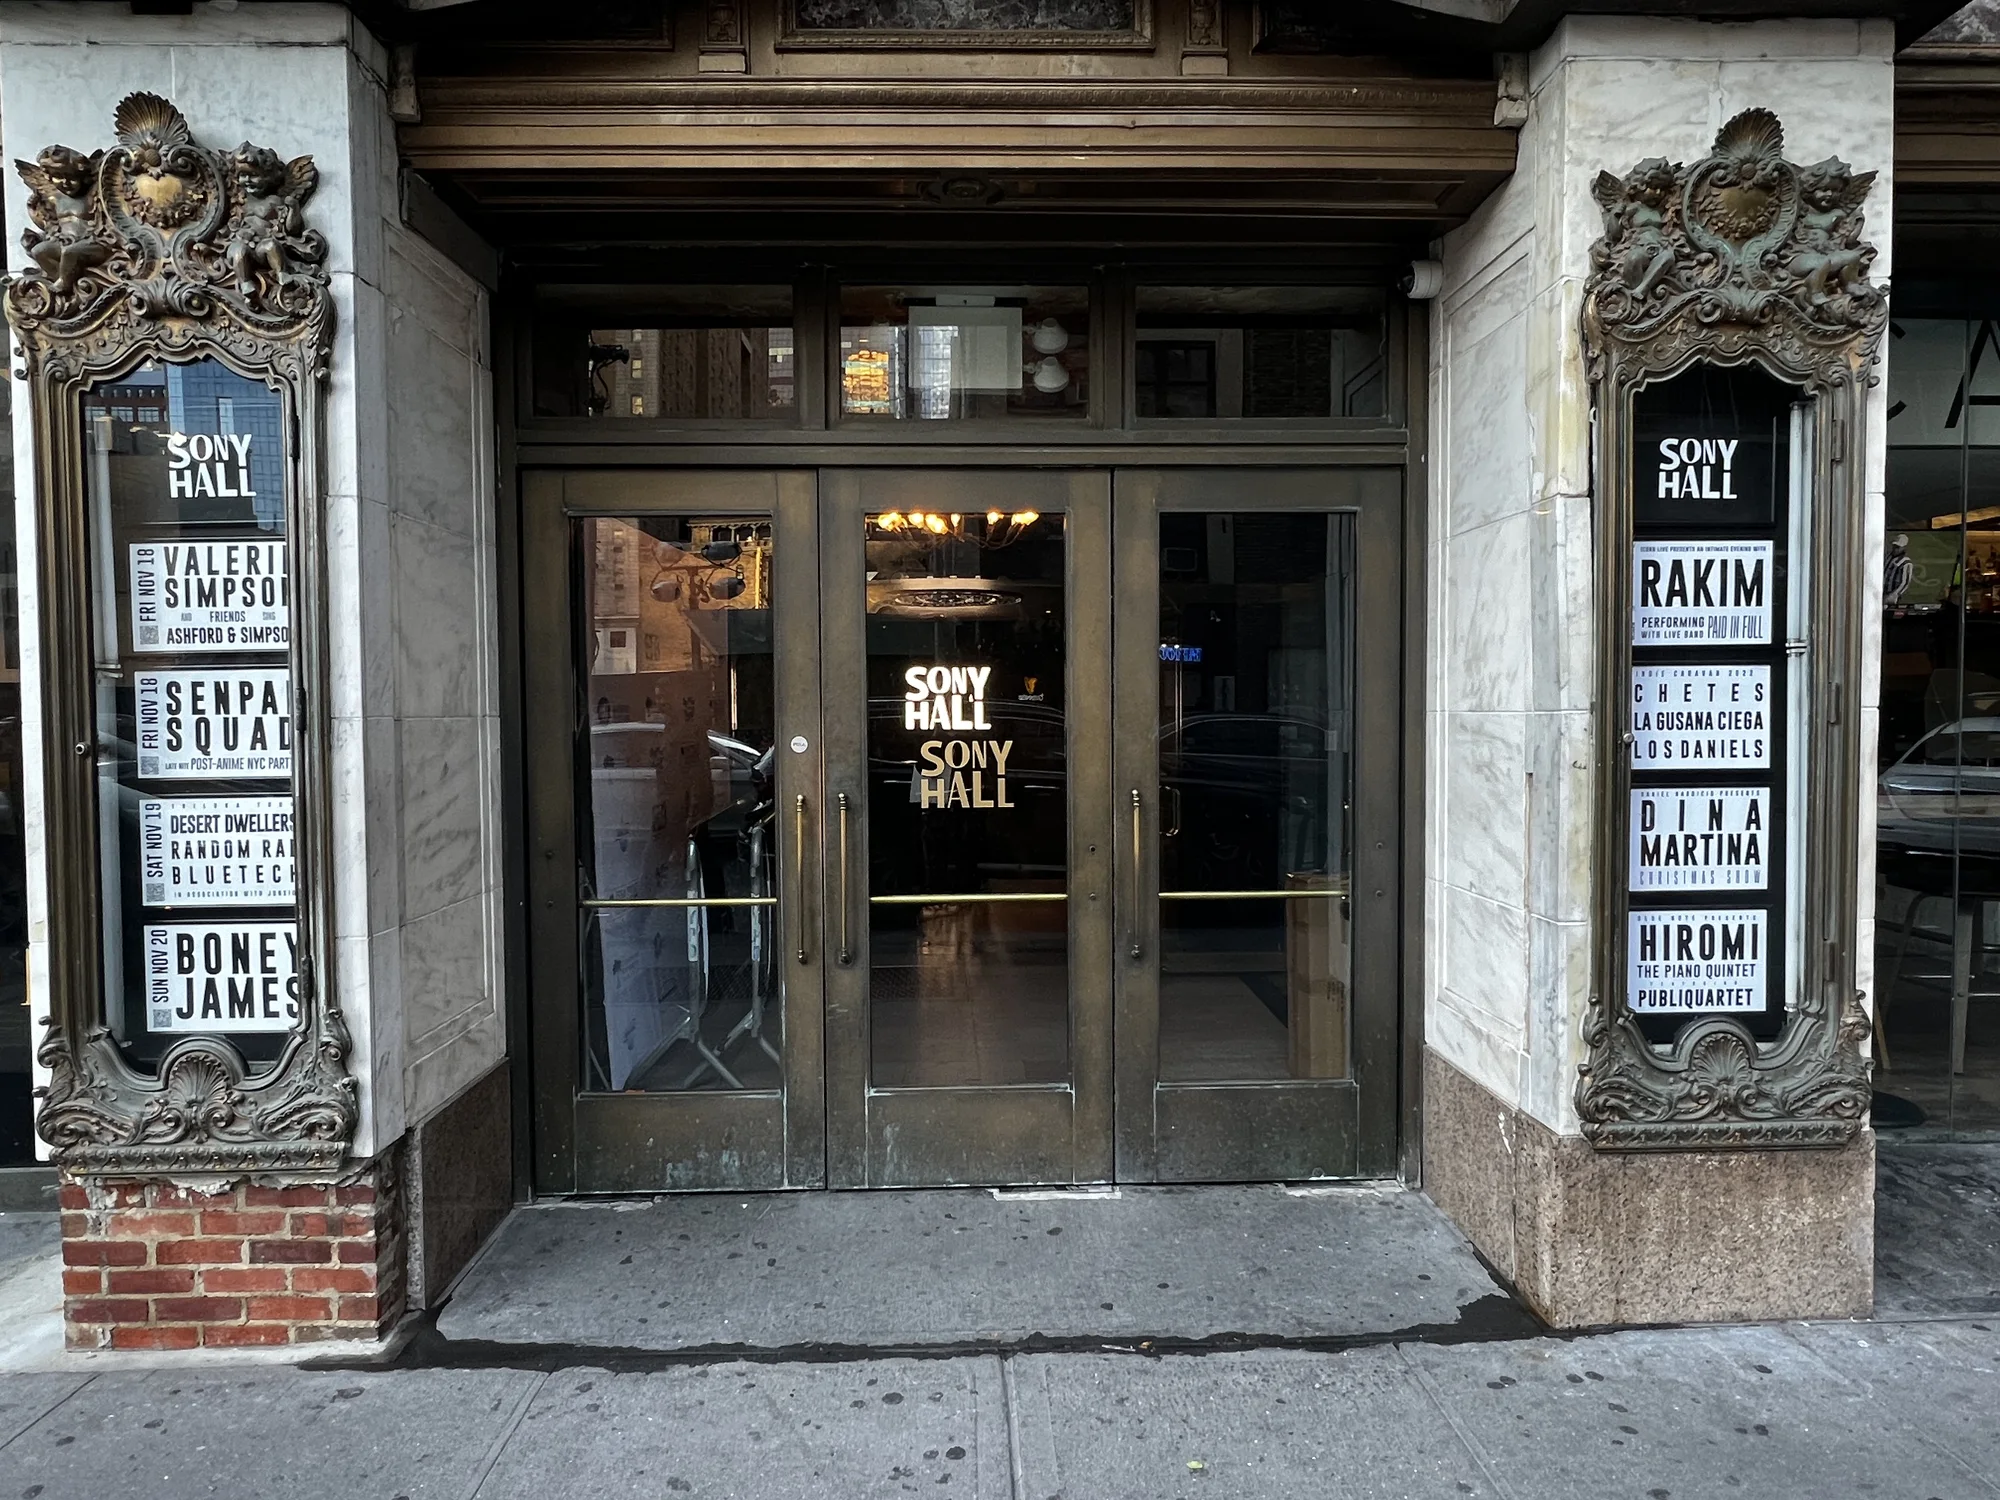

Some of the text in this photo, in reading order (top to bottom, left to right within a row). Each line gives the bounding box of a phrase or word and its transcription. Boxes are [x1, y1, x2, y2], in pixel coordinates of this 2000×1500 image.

[168, 434, 252, 469] SONY
[1659, 437, 1739, 471] SONY
[169, 462, 257, 498] HALL
[1658, 465, 1738, 499] HALL
[164, 545, 286, 577] VALERI
[137, 548, 156, 622] FRI NOV 18
[1641, 559, 1764, 607] RAKIM
[210, 611, 246, 623] FRIENDS
[1641, 616, 1705, 628] PERFORMING
[1708, 615, 1763, 638] PAID IN FULL
[167, 627, 223, 644] ASHFORD
[228, 627, 236, 643] &
[1641, 631, 1660, 639] WITH
[1684, 630, 1704, 638] BAND
[905, 666, 991, 701] SONY
[1634, 683, 1763, 703] CHETES
[141, 678, 158, 749] FRI NOV 18
[905, 694, 991, 730] HALL
[1634, 711, 1763, 731] LA GUSANA CIEGA
[166, 717, 290, 755] SQUAD
[1634, 739, 1763, 759] LOS DANIELS
[191, 757, 244, 770] POST-ANIME
[248, 757, 265, 770] NYC
[268, 757, 291, 769] PART
[920, 740, 1013, 777] SONY
[920, 771, 1014, 809] HALL
[171, 814, 220, 834] DESERT
[1641, 799, 1761, 832] DINA
[145, 803, 164, 877] SAT NOV 19
[171, 840, 250, 859] RANDOM
[1640, 833, 1760, 867] MARTINA
[1640, 870, 1761, 885] CHRISTMAS SHOW
[176, 932, 297, 975] BONEY
[1640, 924, 1758, 961] HIROMI
[151, 930, 169, 1002] SUN NOV 20
[1637, 963, 1756, 979] THE PIANO QUINTET
[176, 976, 298, 1019] JAMES
[1638, 988, 1753, 1009] PUBLIQUARTET
